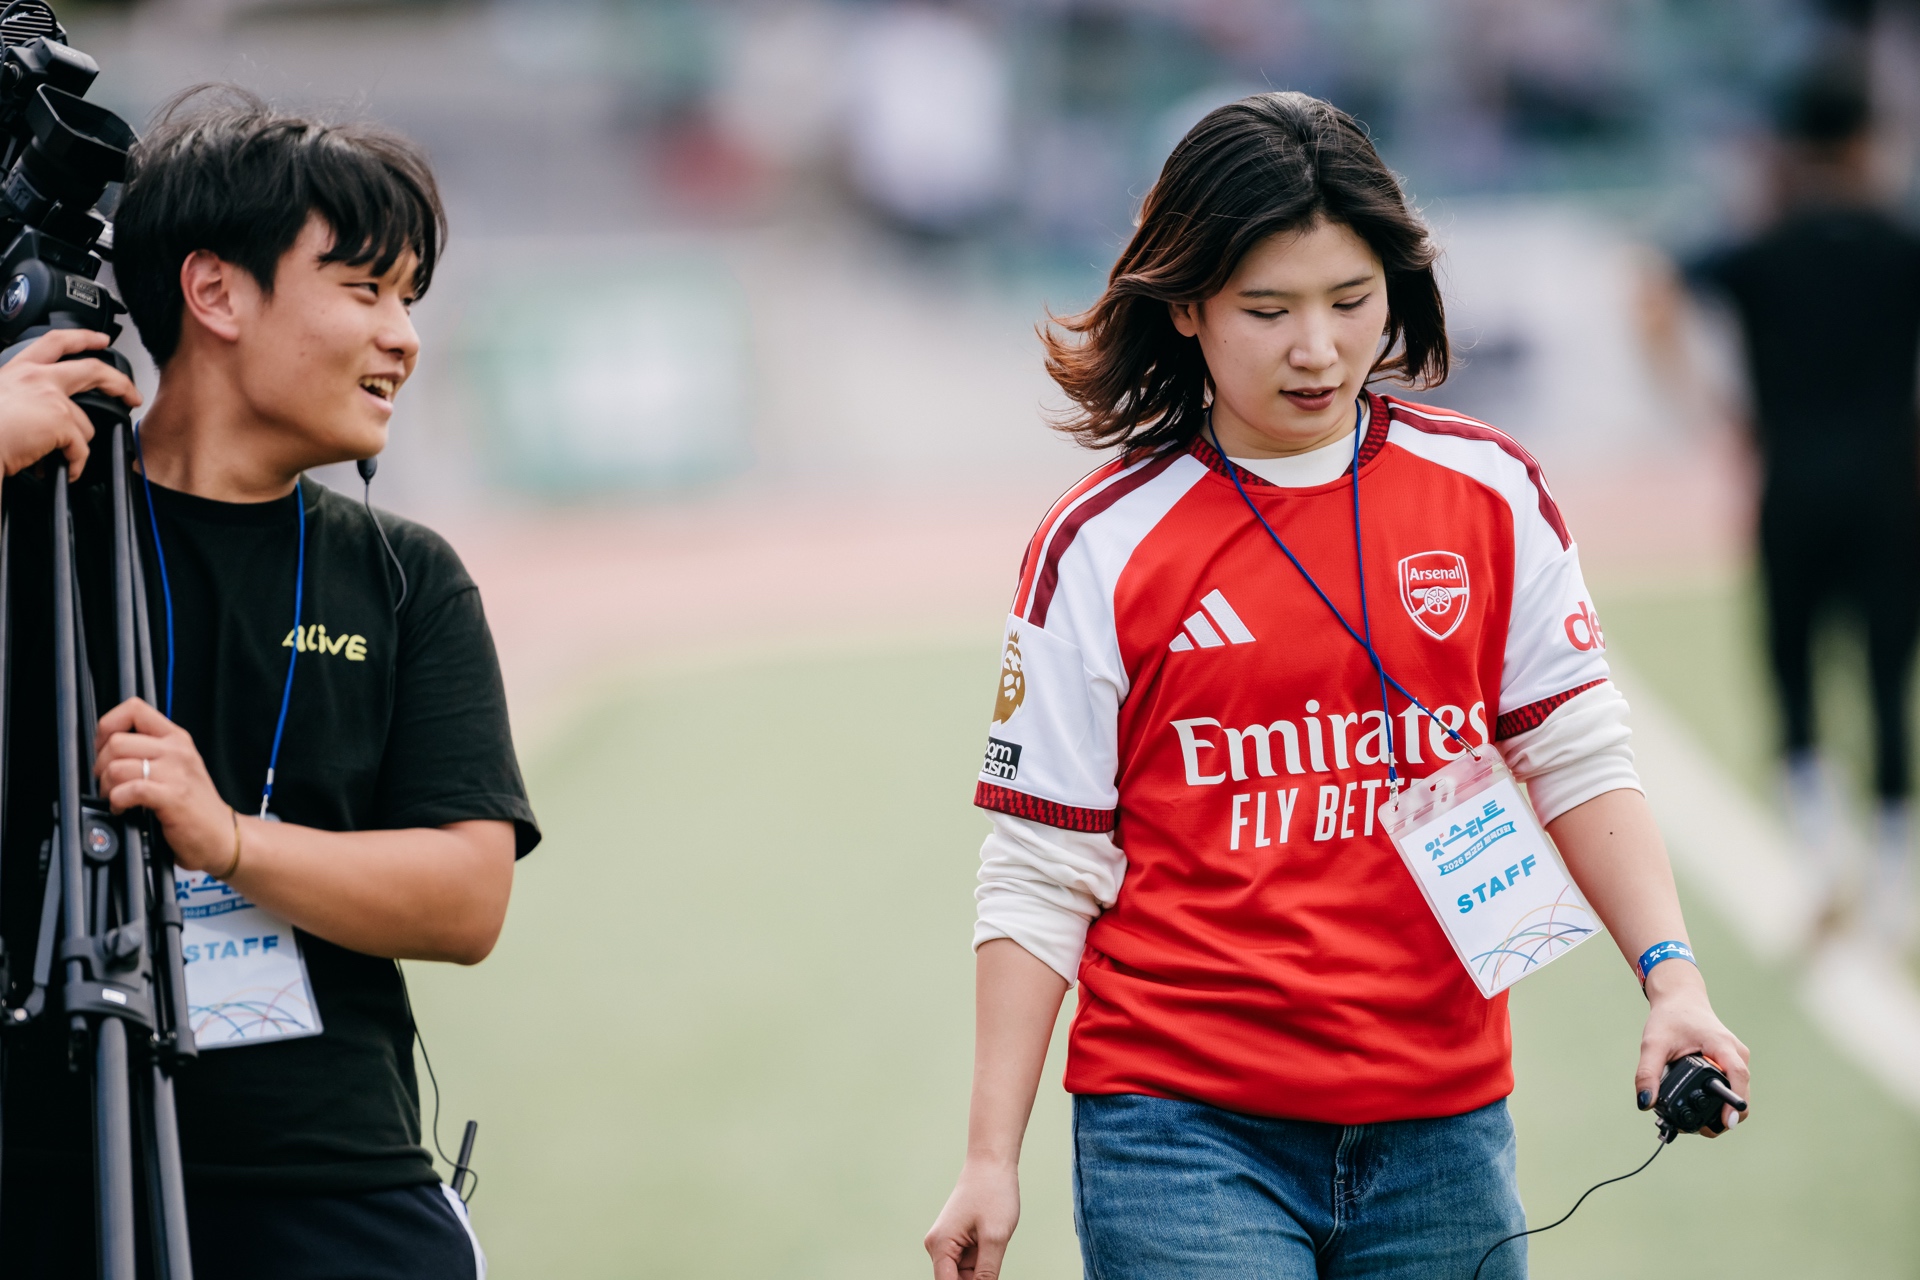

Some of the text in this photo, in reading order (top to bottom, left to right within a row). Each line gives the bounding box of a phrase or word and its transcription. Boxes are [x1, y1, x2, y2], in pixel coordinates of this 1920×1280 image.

[1409, 566, 1461, 581] Arsenal
[986, 741, 1012, 762] om
[1169, 697, 1490, 787] Emirates
[983, 757, 1017, 780] cism
[1230, 787, 1299, 851] FLY
[1443, 856, 1464, 873] 2026
[1456, 853, 1537, 914] STAFF
[183, 935, 279, 963] STAFF
